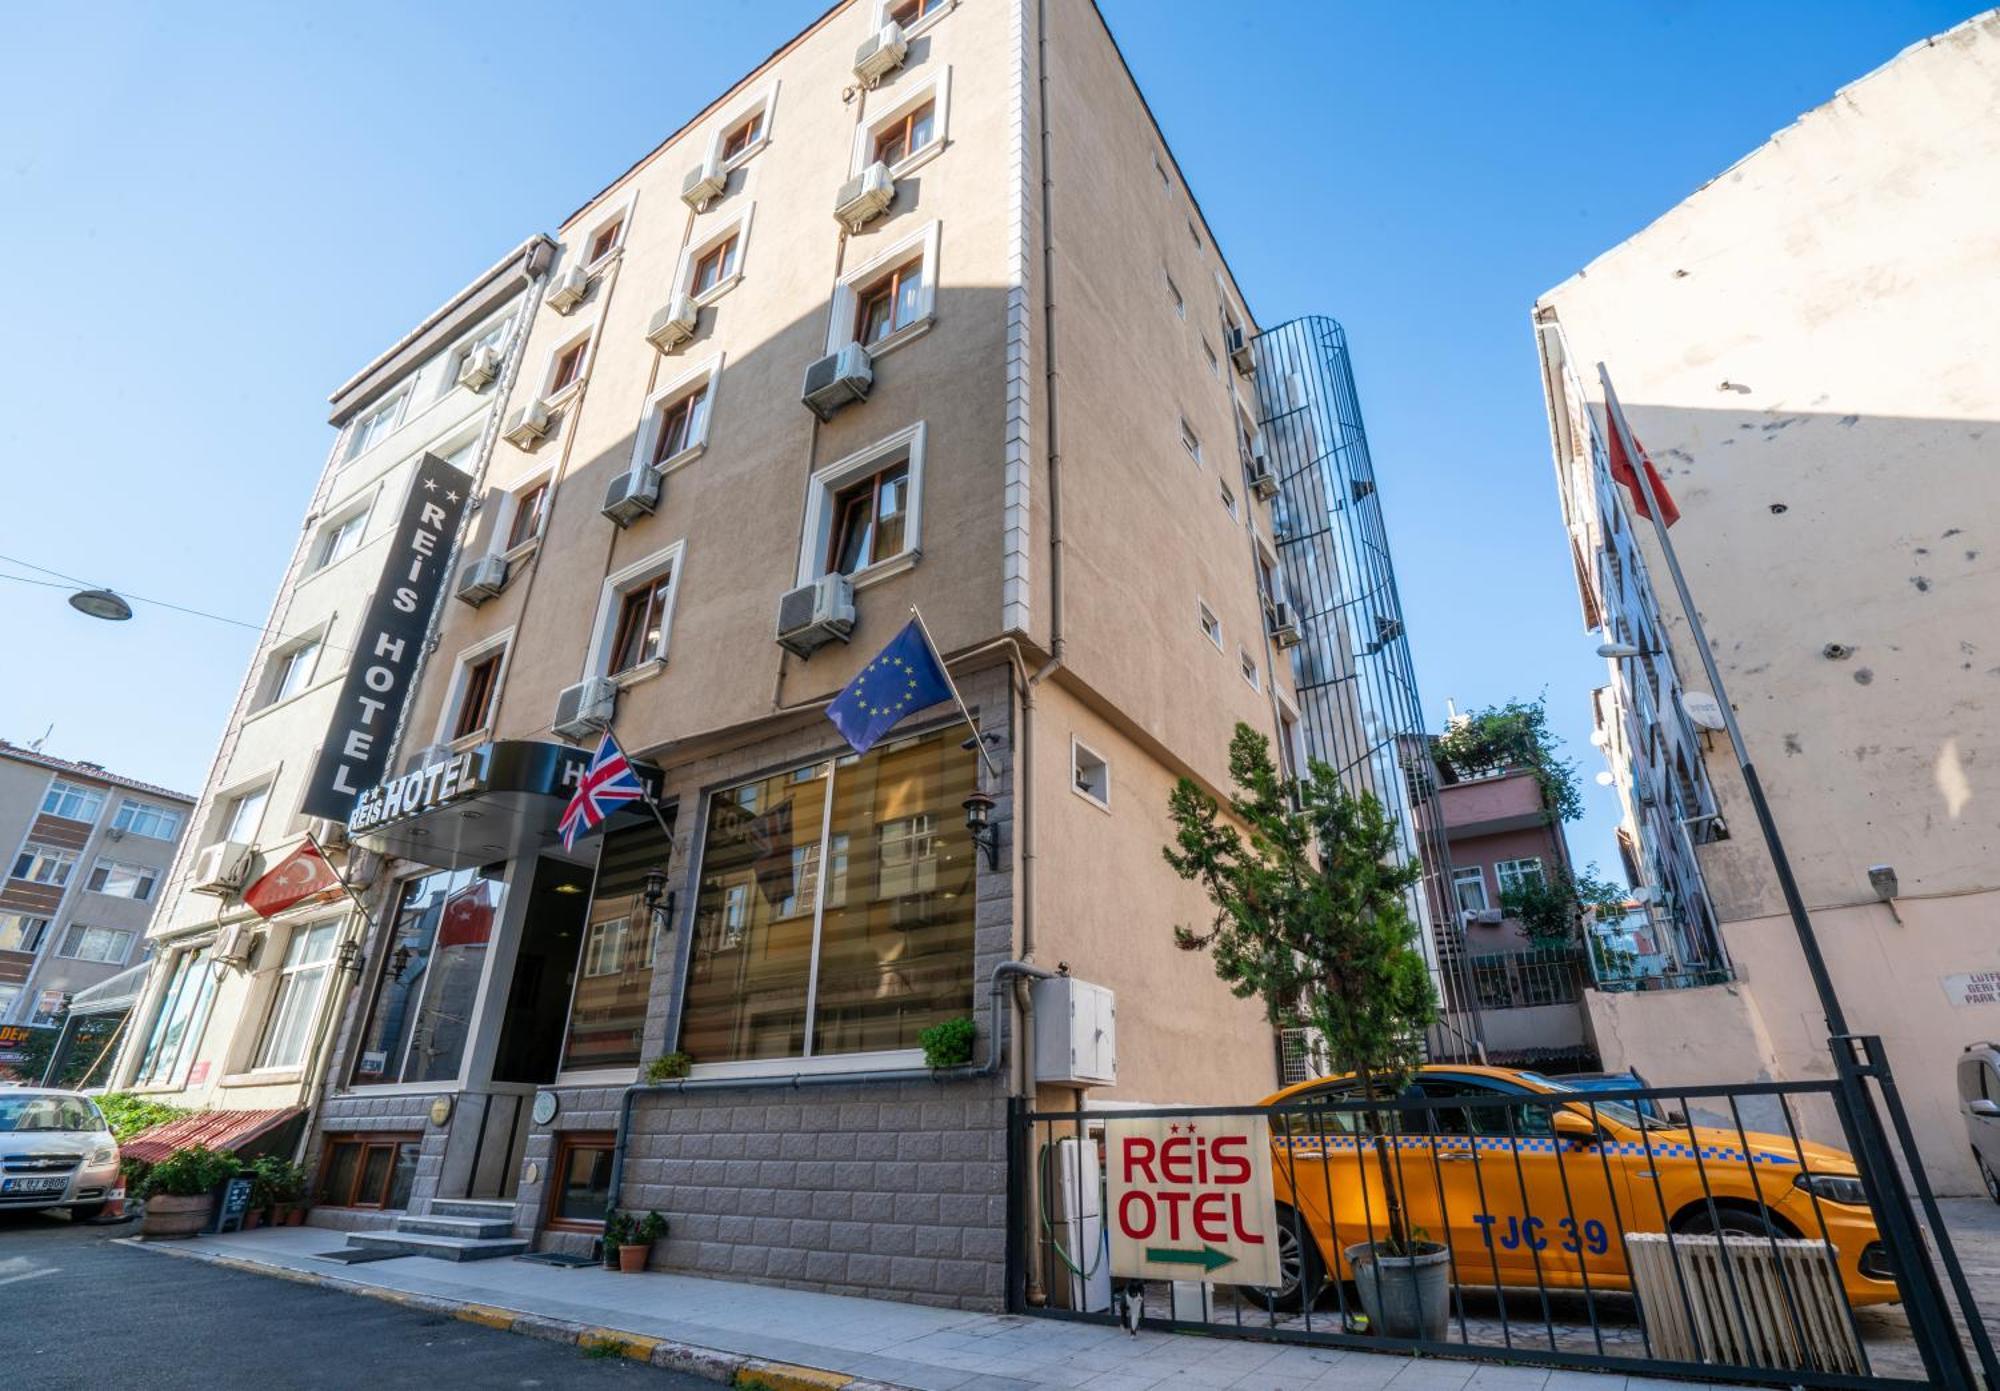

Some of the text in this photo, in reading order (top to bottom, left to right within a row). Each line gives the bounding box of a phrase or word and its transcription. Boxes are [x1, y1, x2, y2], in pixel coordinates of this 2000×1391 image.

[332, 632, 406, 796] HOTEL
[381, 752, 476, 820] HOTEL
[1965, 993, 1996, 1004] PARK
[1119, 1190, 1264, 1244] OTEL
[1473, 1215, 1609, 1255] TJC 39
